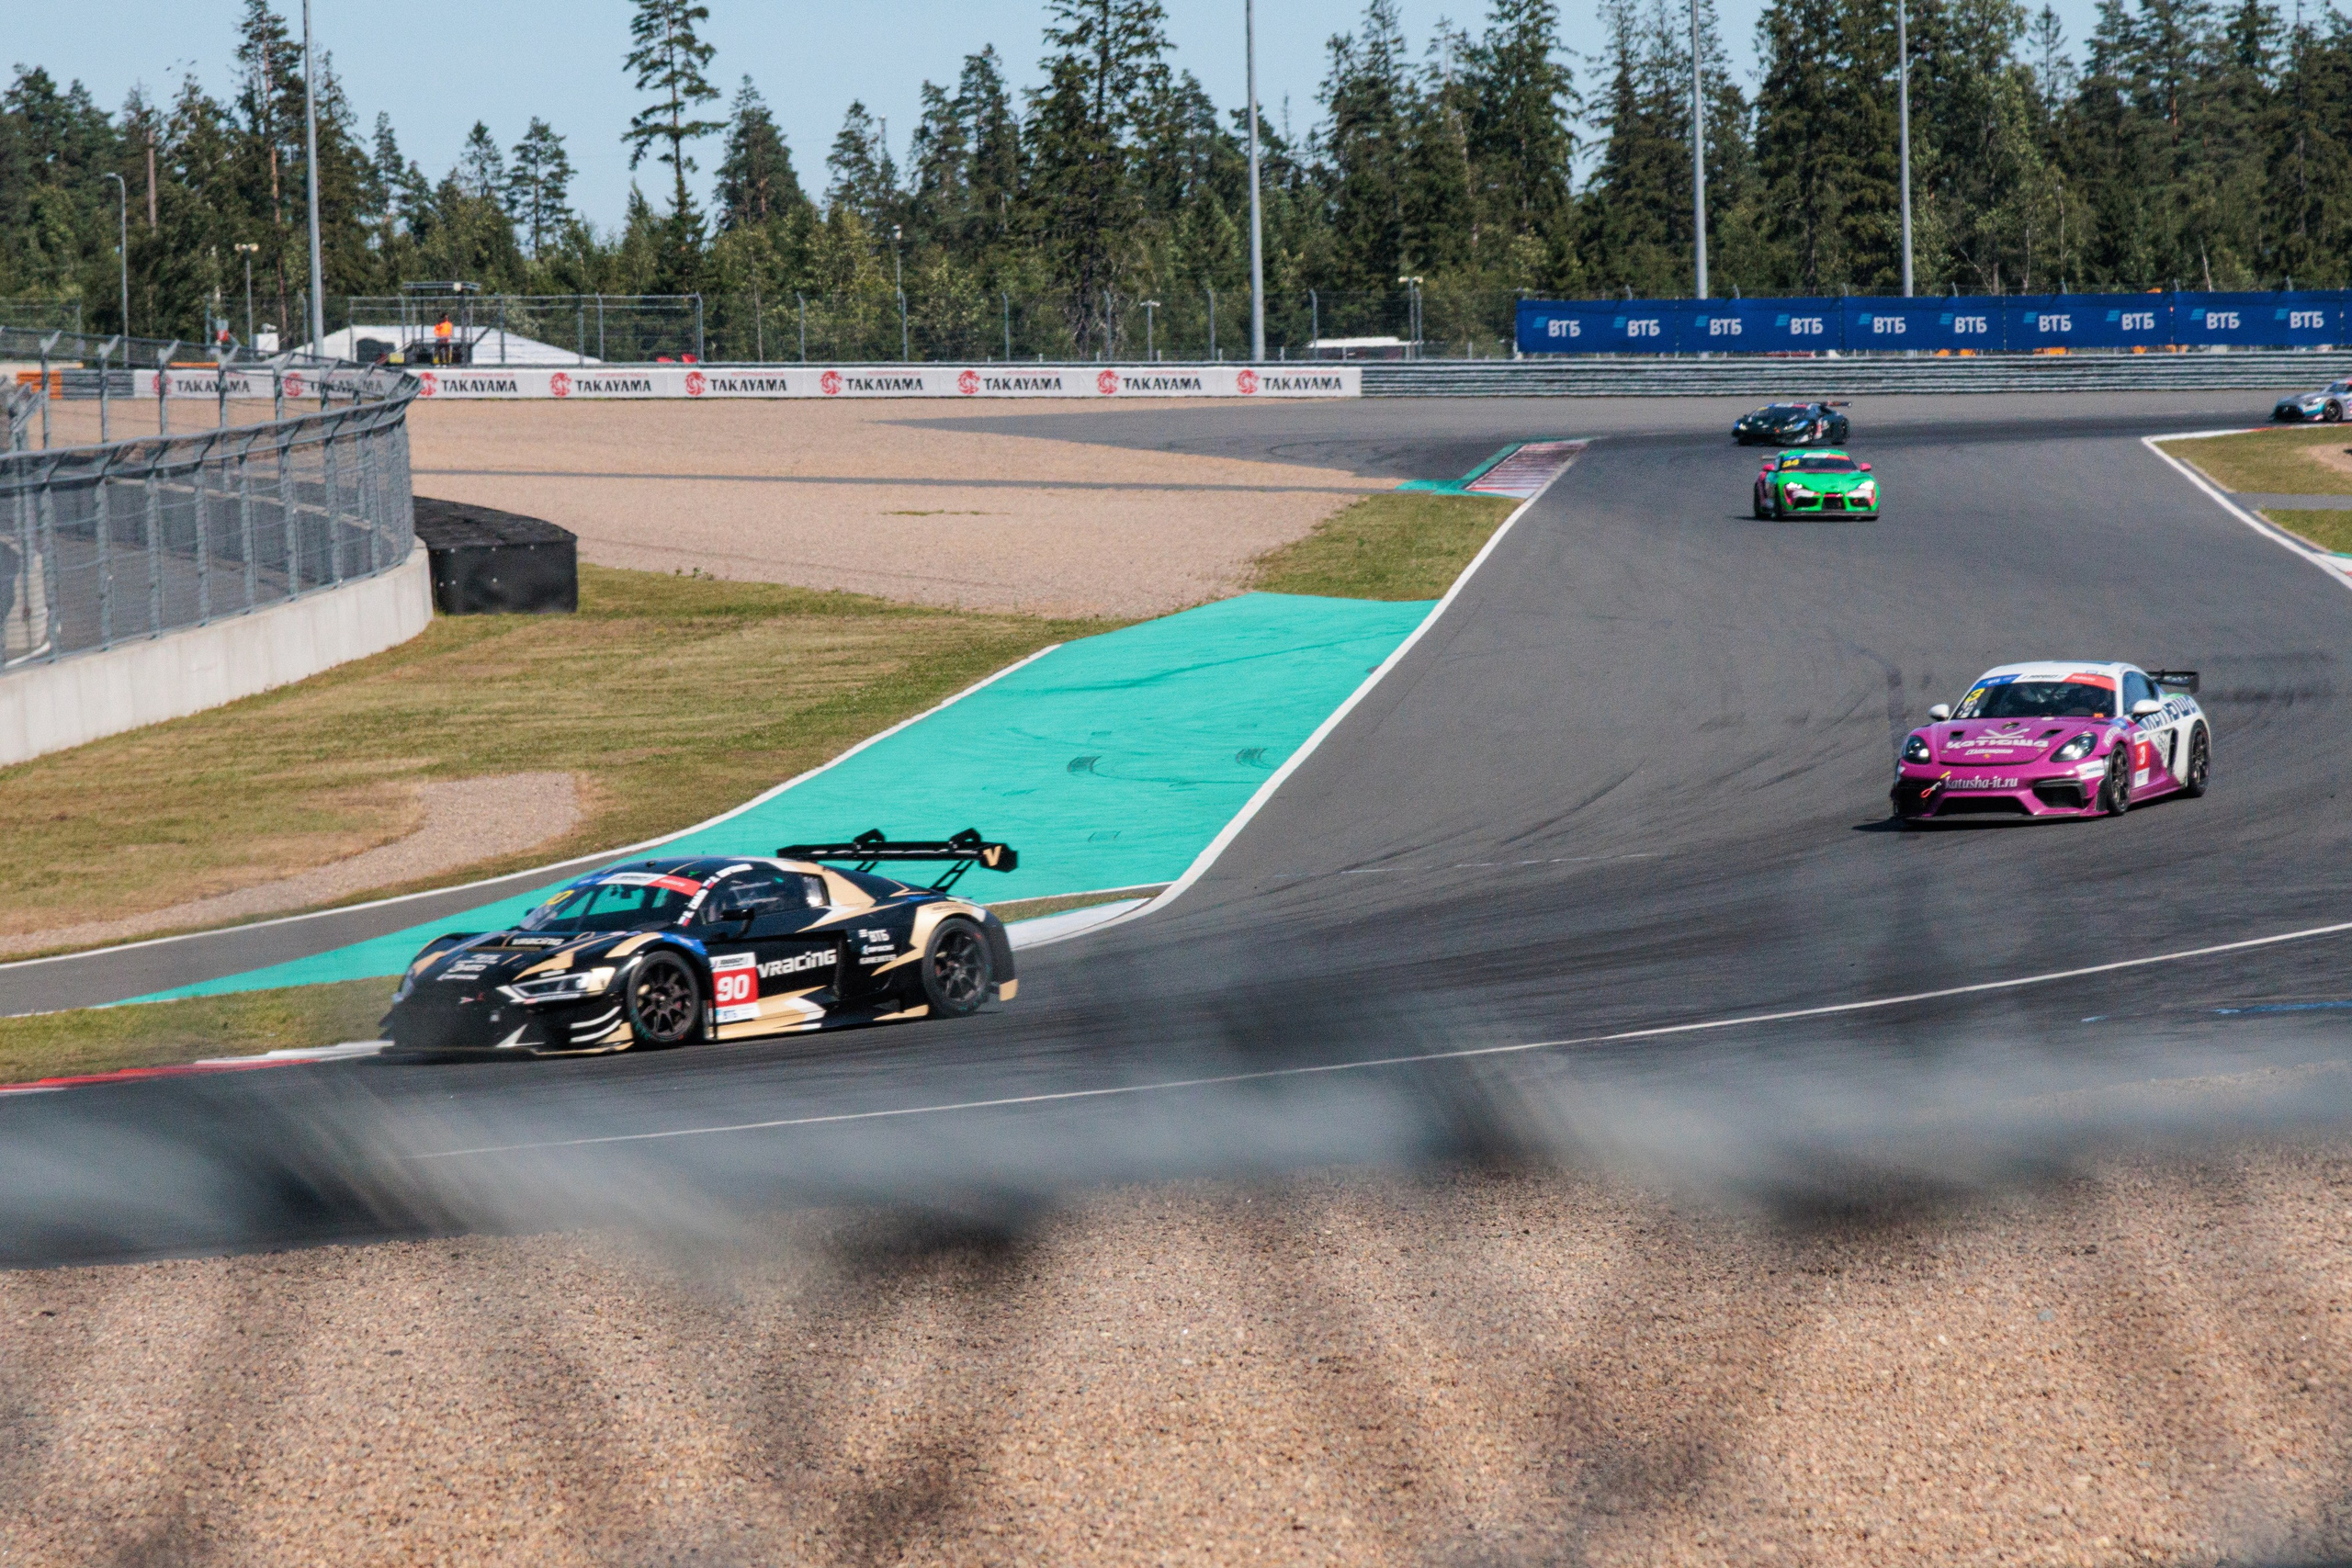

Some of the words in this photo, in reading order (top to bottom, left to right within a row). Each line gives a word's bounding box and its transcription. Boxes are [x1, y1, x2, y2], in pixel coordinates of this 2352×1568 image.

[1548, 320, 1580, 337] ВТБ
[1627, 320, 1660, 337] ВТБ
[1710, 318, 1742, 335] ВТБ
[1791, 317, 1824, 335] ВТБ
[1873, 317, 1906, 334] ВТБ
[1954, 316, 1987, 333] ВТБ
[2039, 314, 2072, 333] ВТБ
[2121, 313, 2154, 331] ВТБ
[2206, 312, 2240, 330] ВТБ
[2290, 311, 2324, 329] ВТБ
[442, 379, 517, 392] TAKAYAMA
[576, 379, 651, 392] TAKAYAMA
[710, 378, 787, 391] TAKAYAMA
[845, 378, 923, 390] TAKAYAMA
[983, 378, 1062, 390] TAKAYAMA
[1123, 378, 1202, 390] TAKAYAMA
[1263, 377, 1341, 390] TAKAYAMA
[2139, 745, 2146, 765] 3
[1944, 774, 2018, 789] katusha-it.ru
[716, 974, 751, 1002] 90
